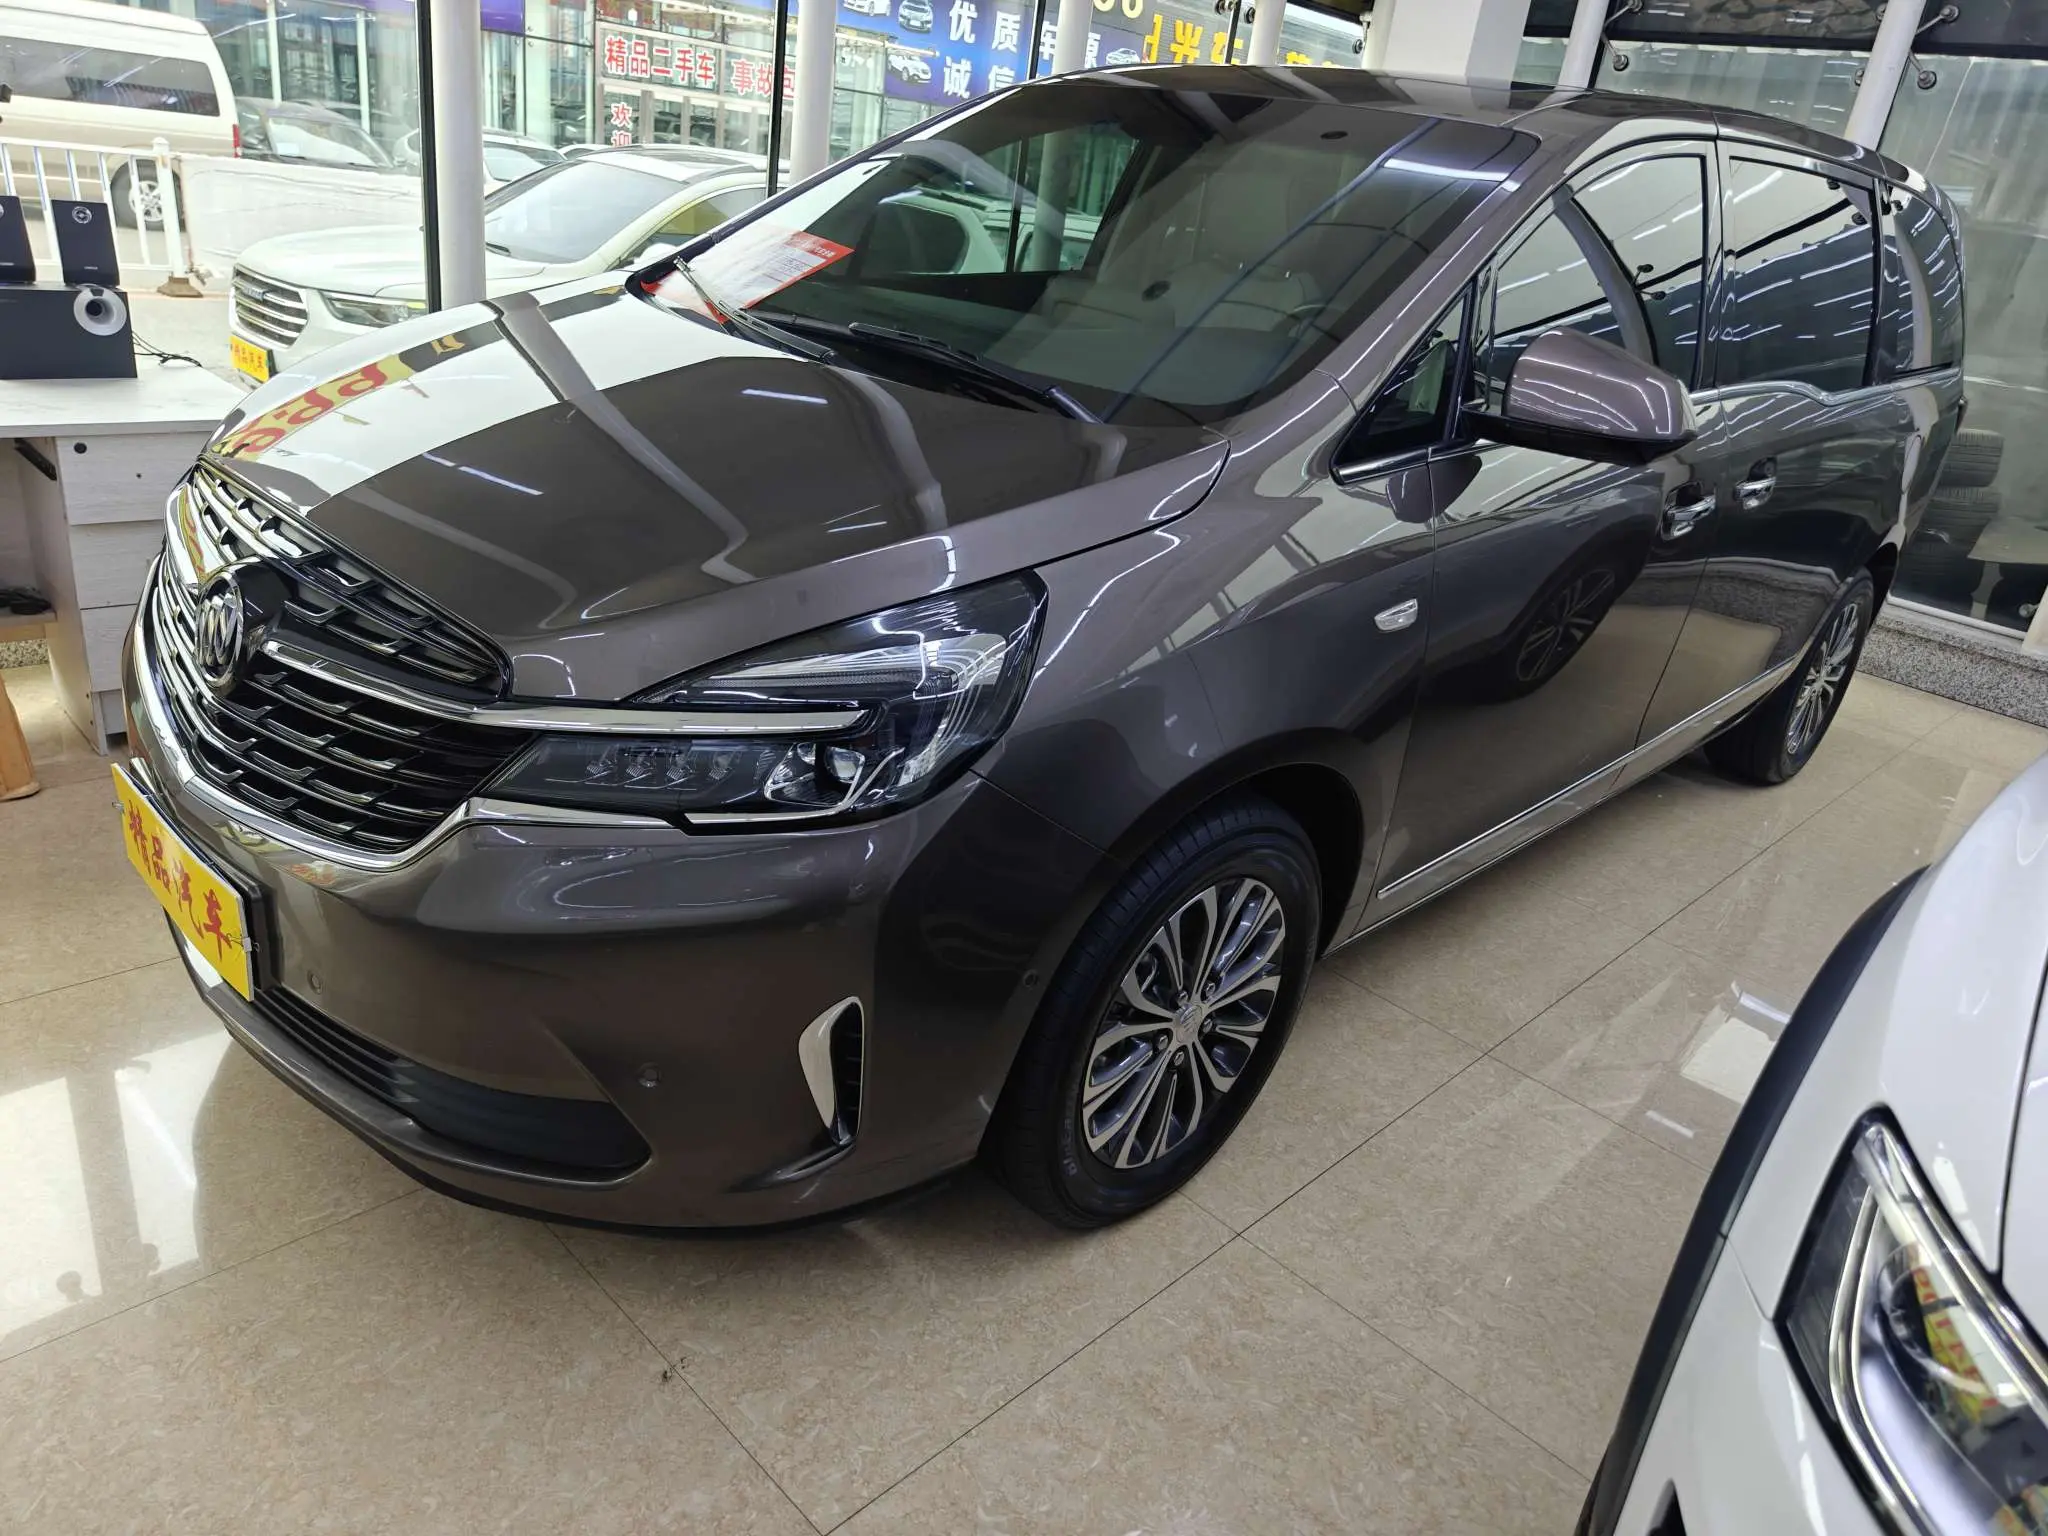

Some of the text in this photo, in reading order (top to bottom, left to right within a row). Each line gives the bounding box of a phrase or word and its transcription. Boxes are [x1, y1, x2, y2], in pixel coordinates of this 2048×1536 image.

[605, 36, 716, 86] 精品二手车
